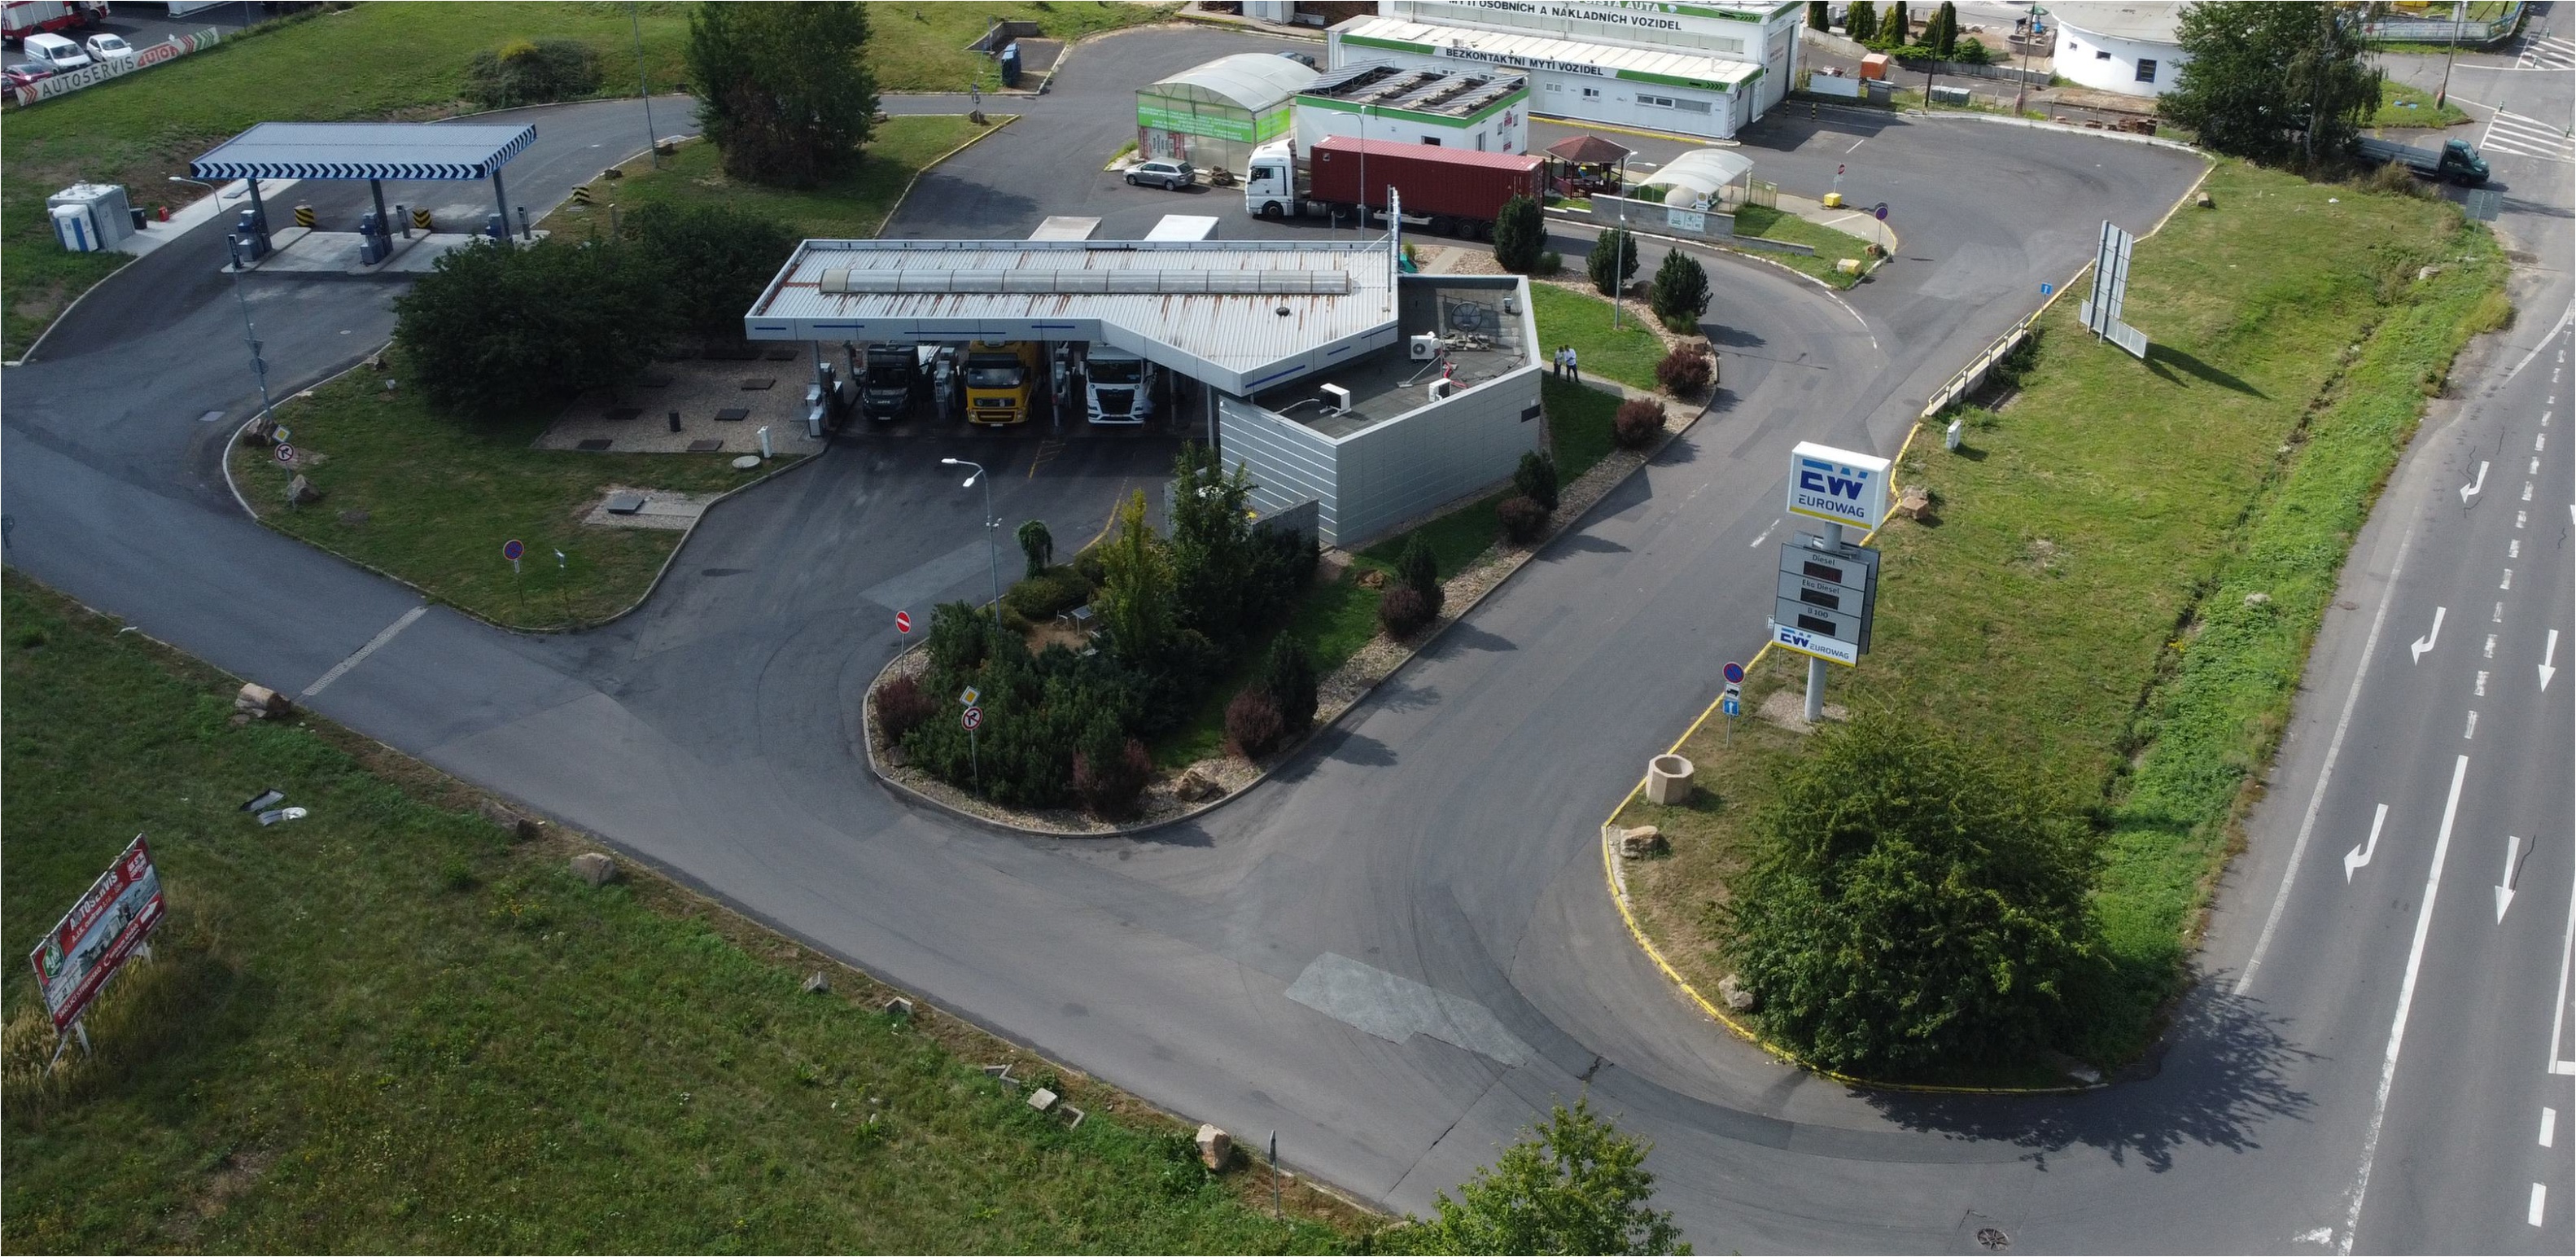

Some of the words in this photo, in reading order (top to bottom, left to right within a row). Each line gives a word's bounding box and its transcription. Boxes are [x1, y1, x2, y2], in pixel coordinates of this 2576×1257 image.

[1479, 0, 1535, 12] OSOBNÍCH
[1540, 6, 1548, 15] A
[1551, 7, 1627, 24] NÁKLADNÍCH
[1631, 15, 1682, 30] VOZIDEL
[1625, 1, 1660, 12] AUTA
[1445, 48, 1525, 66] BEZKONTAKTNÍ
[1529, 59, 1555, 70] MYTÍ
[1559, 62, 1604, 76] VOZIDEL
[42, 55, 134, 97] AUTOSERVIS
[1800, 458, 1868, 500] EW
[1799, 493, 1865, 518] EUROWAG
[1812, 554, 1835, 566] Diesel
[1817, 581, 1840, 594] Diesel
[1814, 609, 1829, 619] 100
[1809, 643, 1849, 659] EUROWAG
